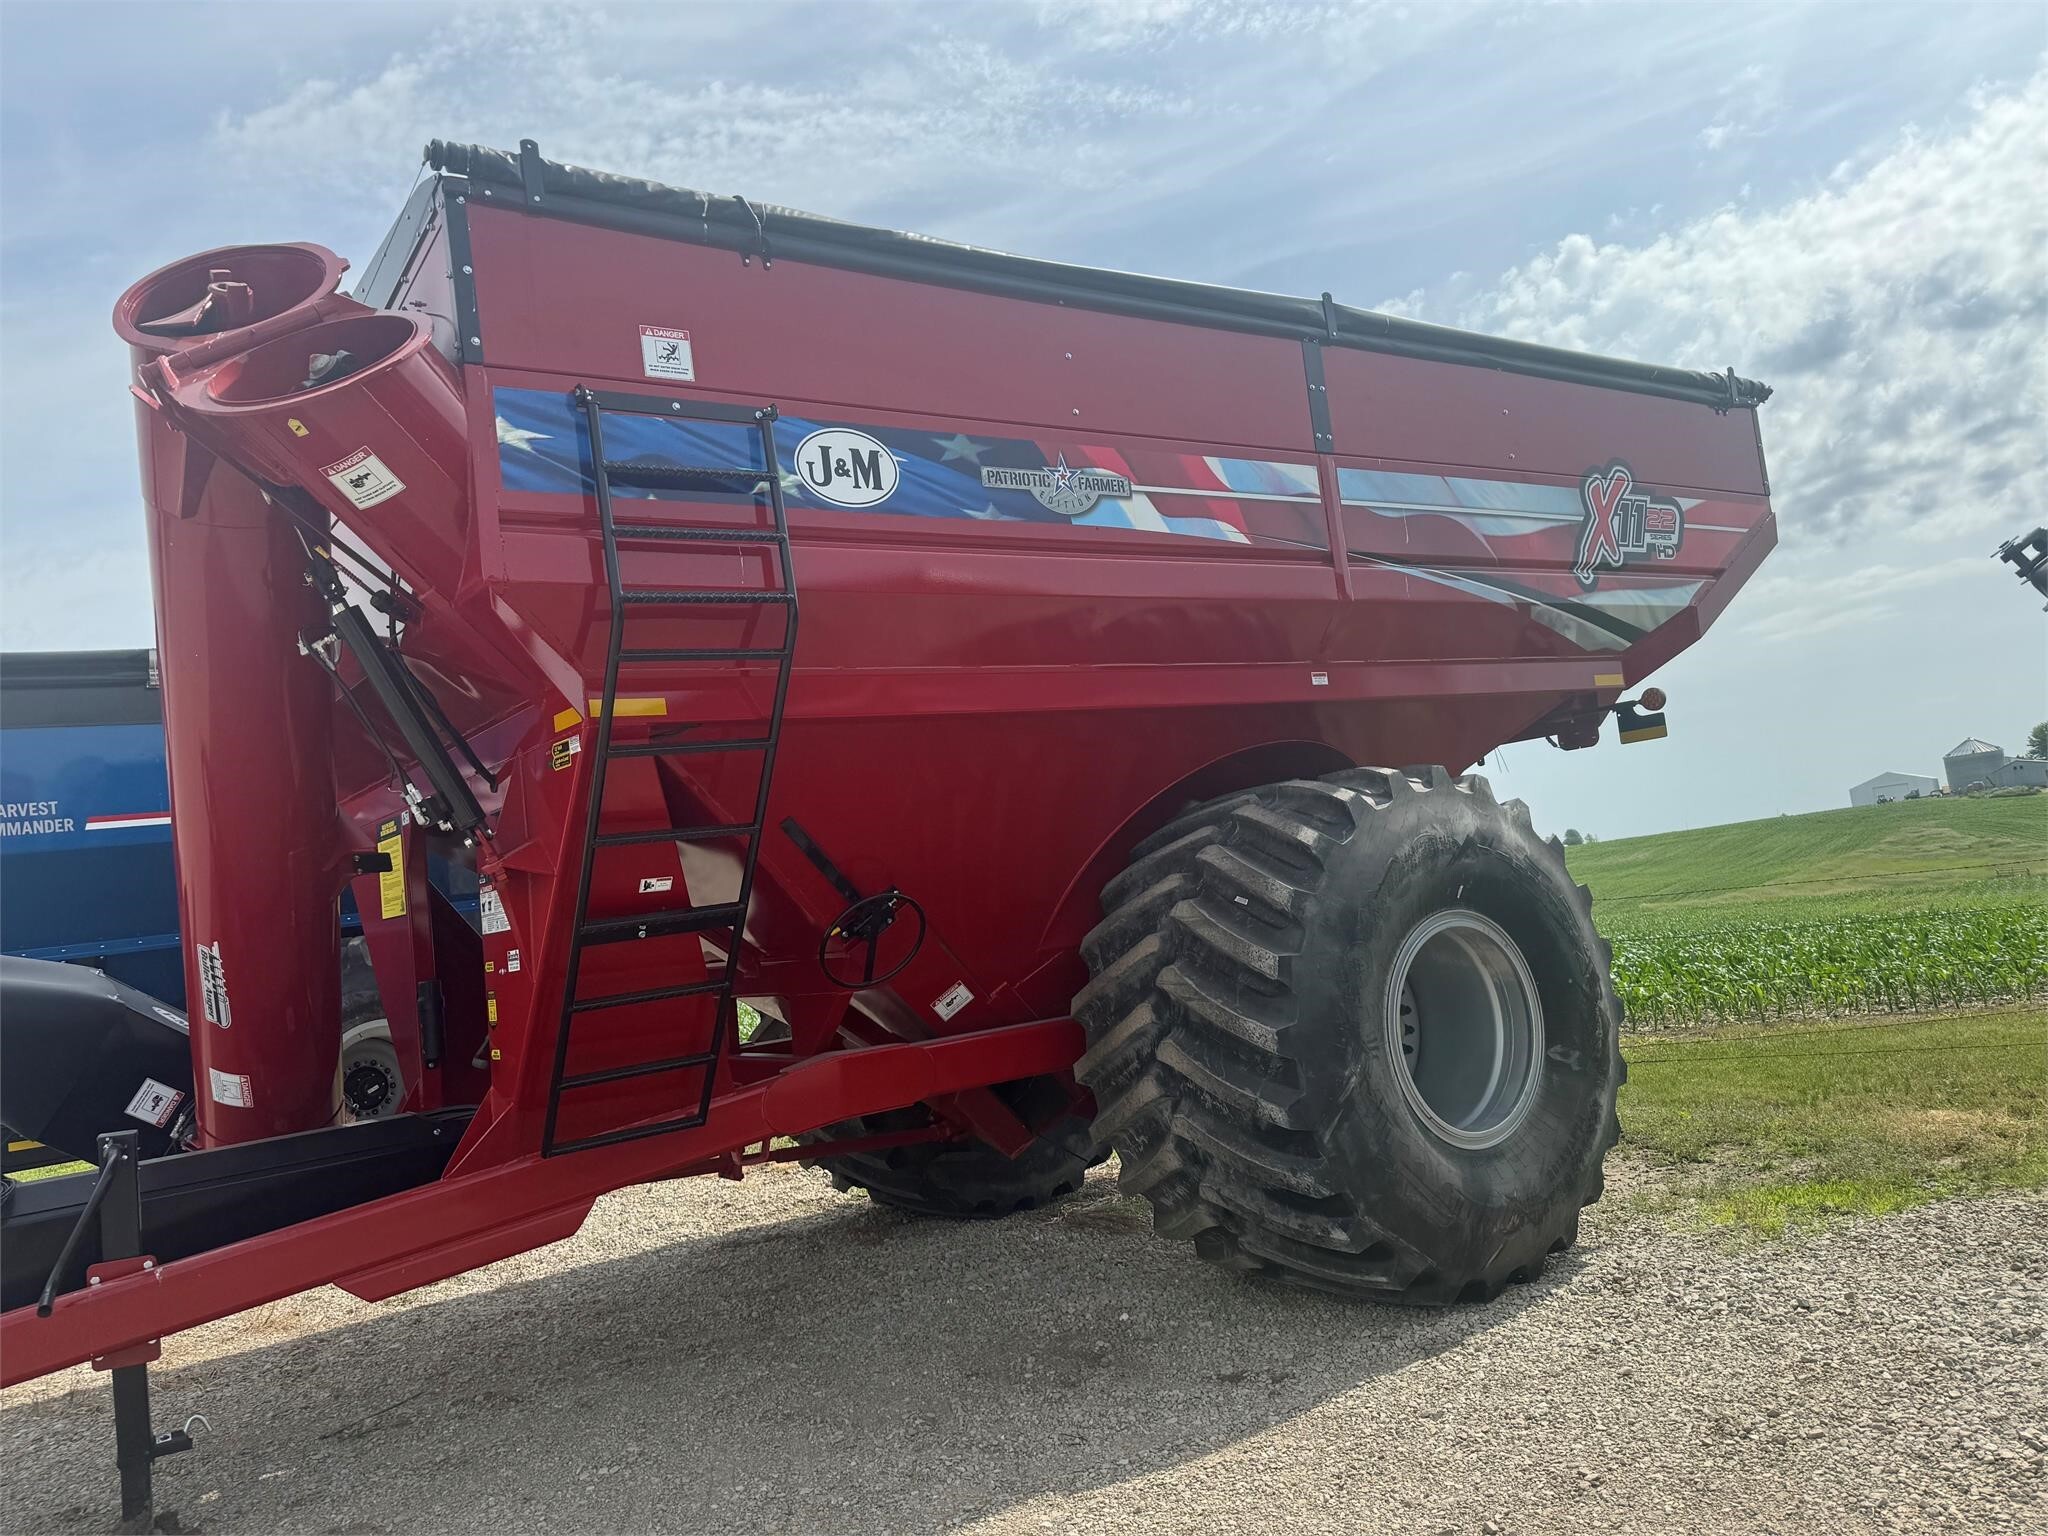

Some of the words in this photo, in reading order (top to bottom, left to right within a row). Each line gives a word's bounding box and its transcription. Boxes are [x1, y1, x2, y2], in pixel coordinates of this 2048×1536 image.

[653, 329, 684, 339] DANGER
[333, 451, 367, 472] DANGER
[805, 445, 884, 491] J&M
[986, 469, 1051, 488] PATRIOTIC
[1077, 476, 1126, 493] FARMER
[1039, 489, 1092, 508] EDITION
[1655, 543, 1677, 560] HD
[200, 949, 210, 983] Bullet
[205, 986, 215, 1020] Auger
[241, 1082, 251, 1106] DANGER
